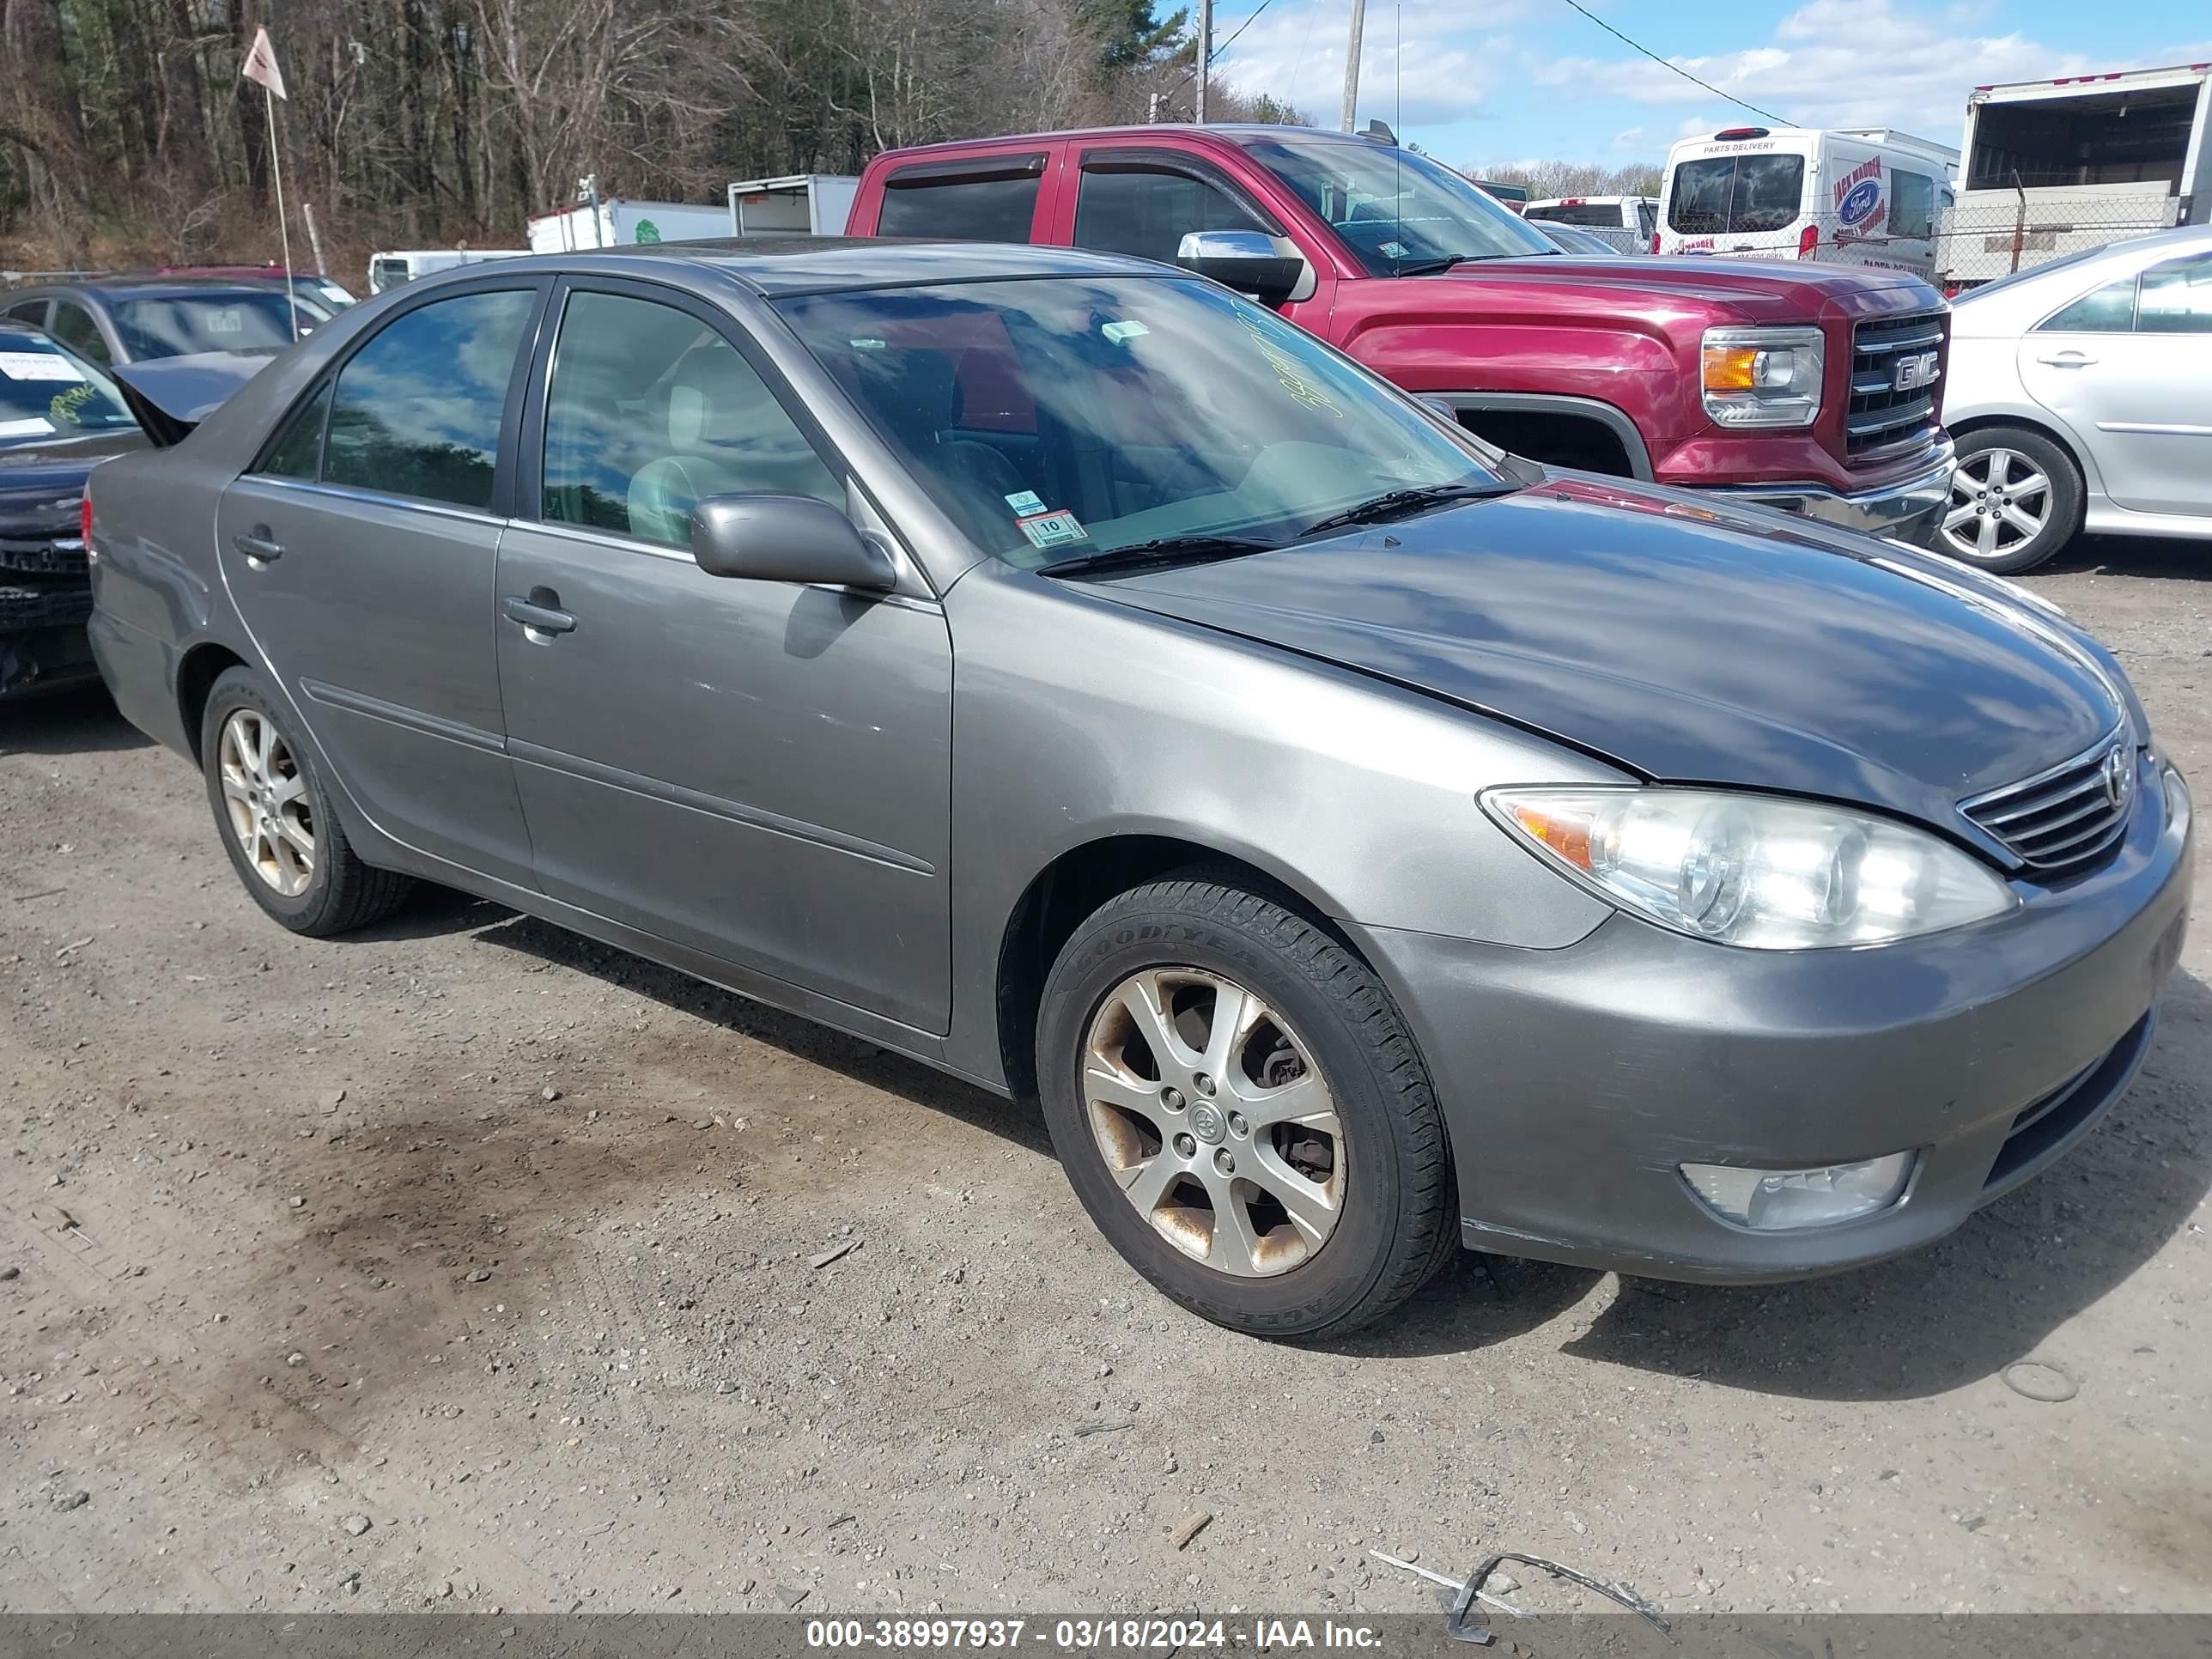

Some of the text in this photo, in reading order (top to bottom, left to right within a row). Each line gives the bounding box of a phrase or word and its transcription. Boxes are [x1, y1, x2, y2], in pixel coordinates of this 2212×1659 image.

[1704, 142, 1776, 154] PARTS DELIVERY
[1833, 155, 1882, 211] JACK MADDEN
[1848, 188, 1872, 221] Ford
[1685, 237, 1715, 250] MADDEN
[1895, 350, 1942, 392] GMC
[1040, 520, 1060, 532] 10
[1076, 923, 1291, 992] GOODYEAR
